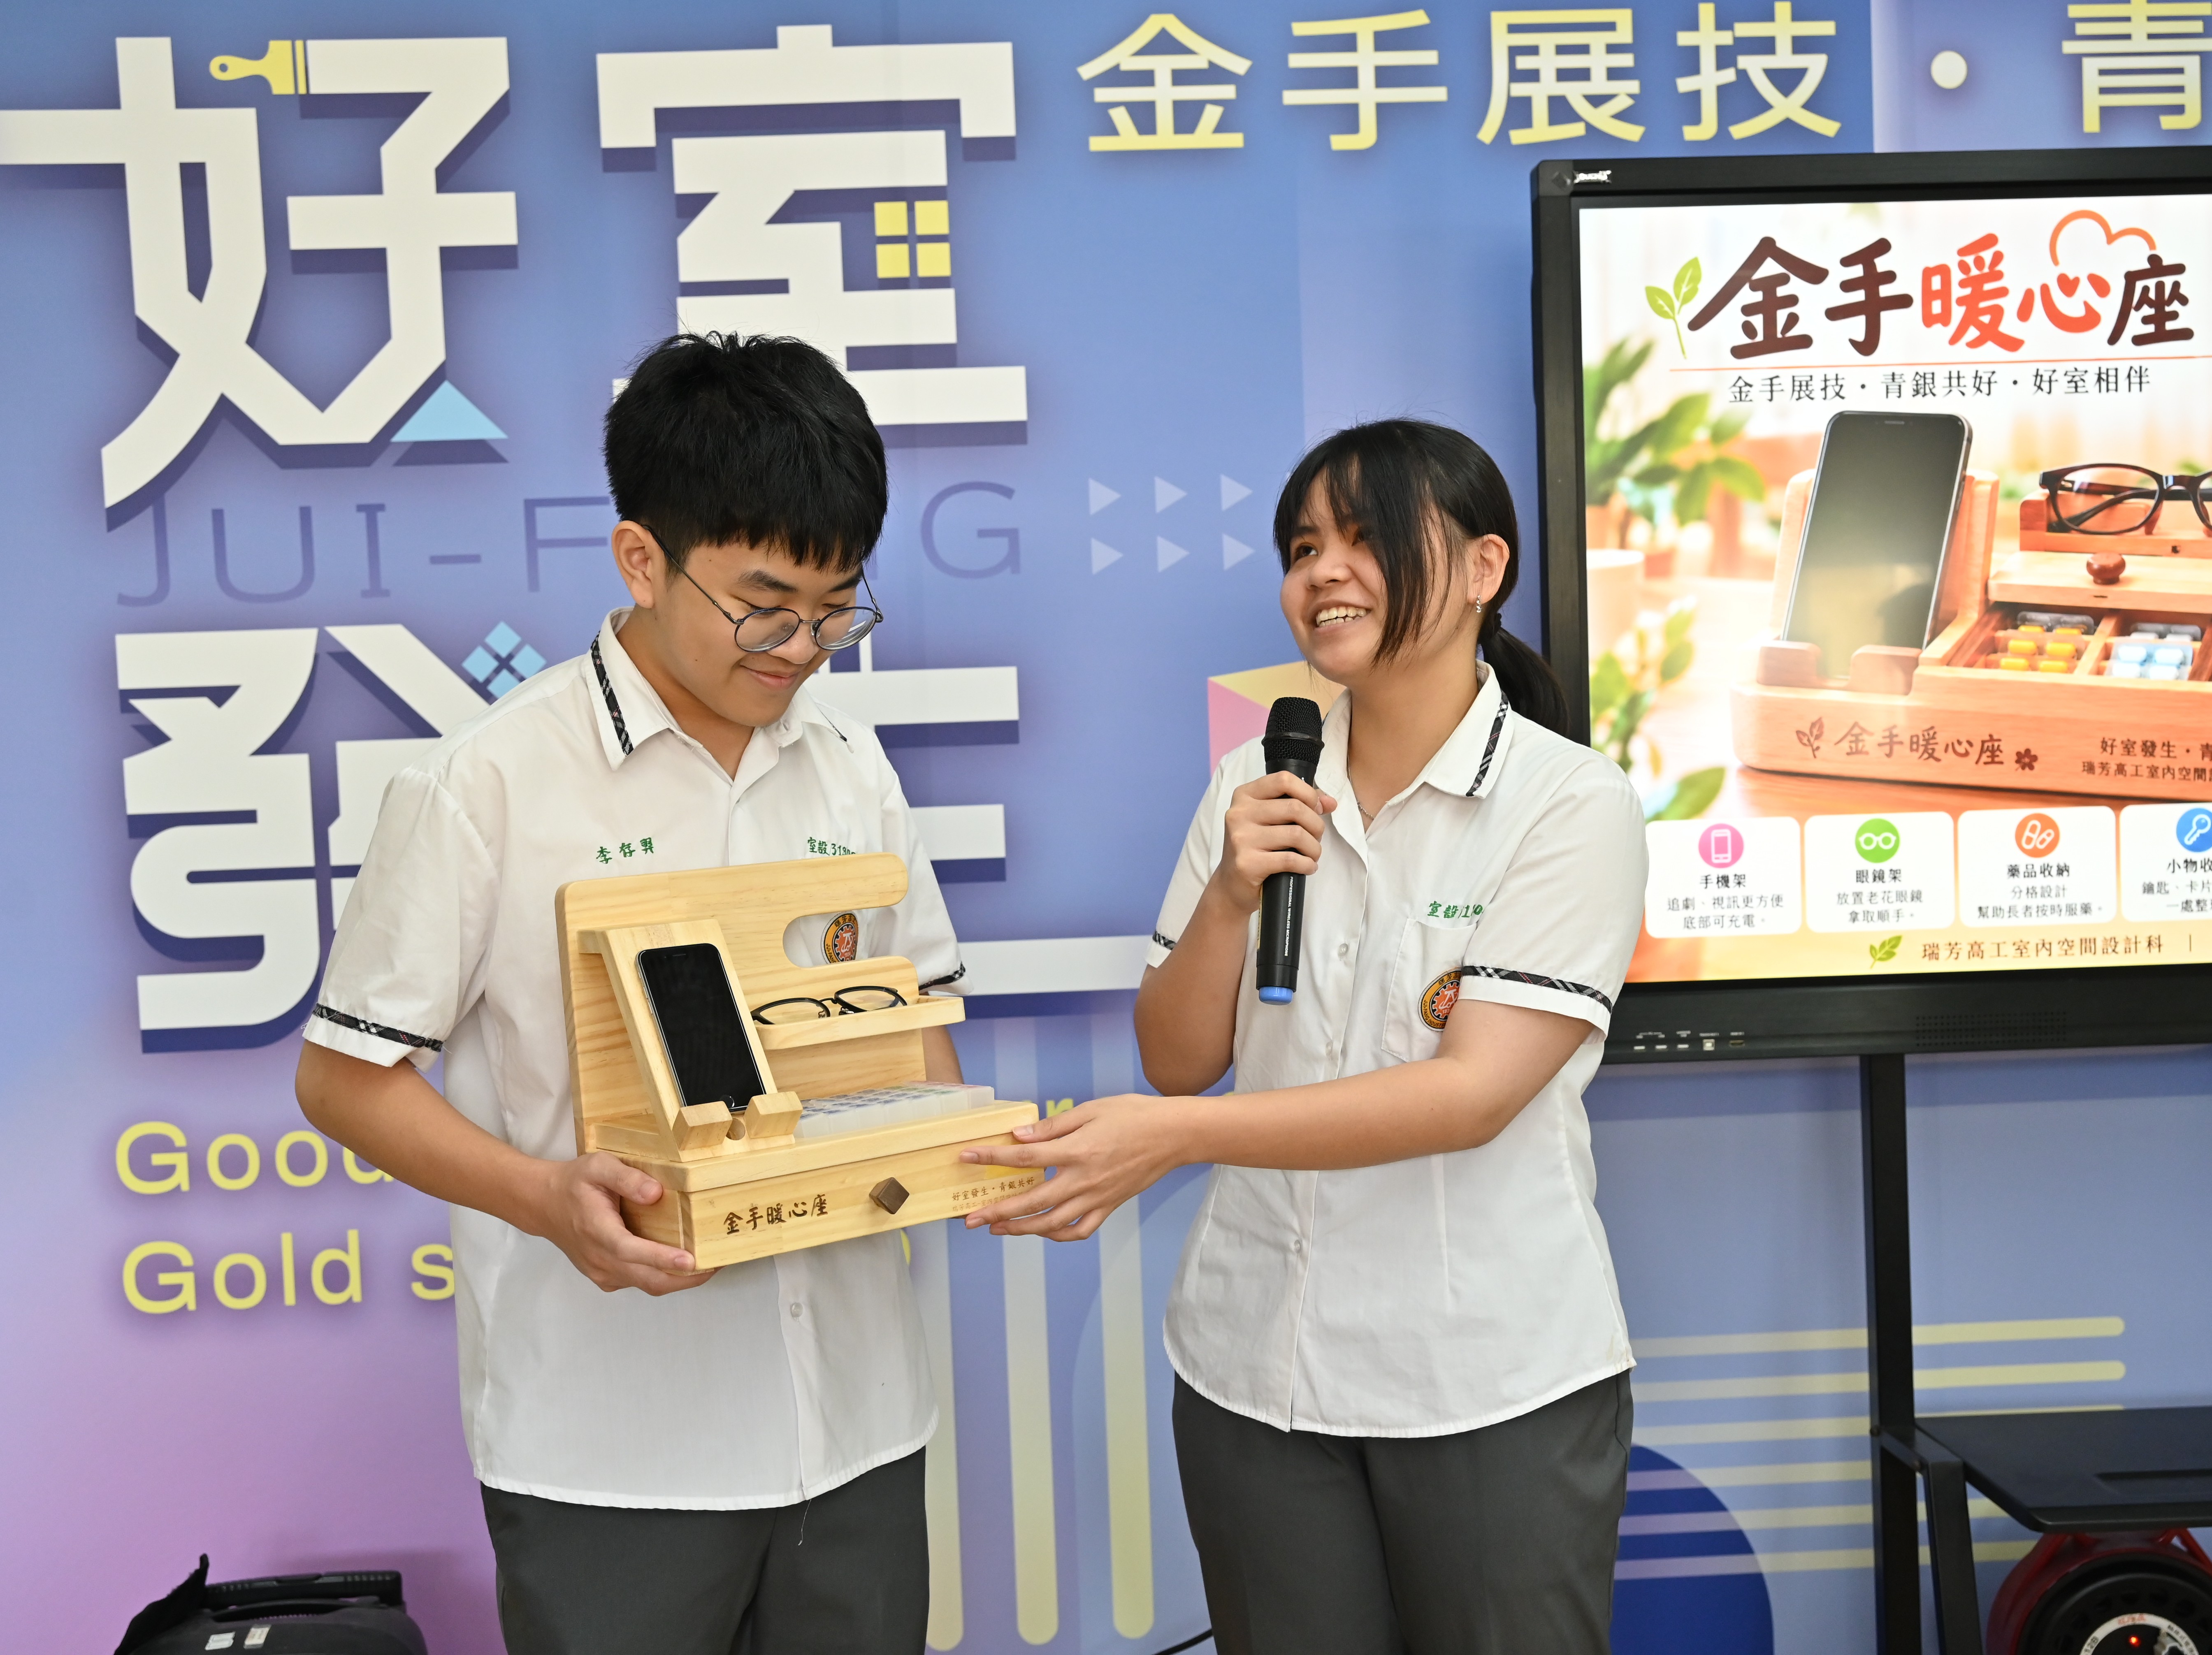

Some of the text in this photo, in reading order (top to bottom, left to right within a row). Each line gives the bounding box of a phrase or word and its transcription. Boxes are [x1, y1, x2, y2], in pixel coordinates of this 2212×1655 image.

[1687, 233, 2195, 359] 金手暖心座
[115, 481, 1021, 607] JUI-FG
[1834, 721, 2005, 766] 金手暖心座
[2082, 760, 2212, 782] 瑞芳高工室內空間
[1700, 873, 1746, 889] 手機架
[1856, 868, 1901, 883] 眼鏡架
[2007, 862, 2070, 878] 藥品收納
[1837, 889, 1922, 905] 放置老花眼鏡
[2012, 885, 2066, 899] 分格設計
[2166, 898, 2212, 913] 一處整
[1922, 934, 2163, 961] 瑞芳高工室內空間設計科
[115, 1121, 394, 1194] Goo
[723, 1194, 828, 1235] 金手暖心座
[122, 1229, 362, 1314] Gold
